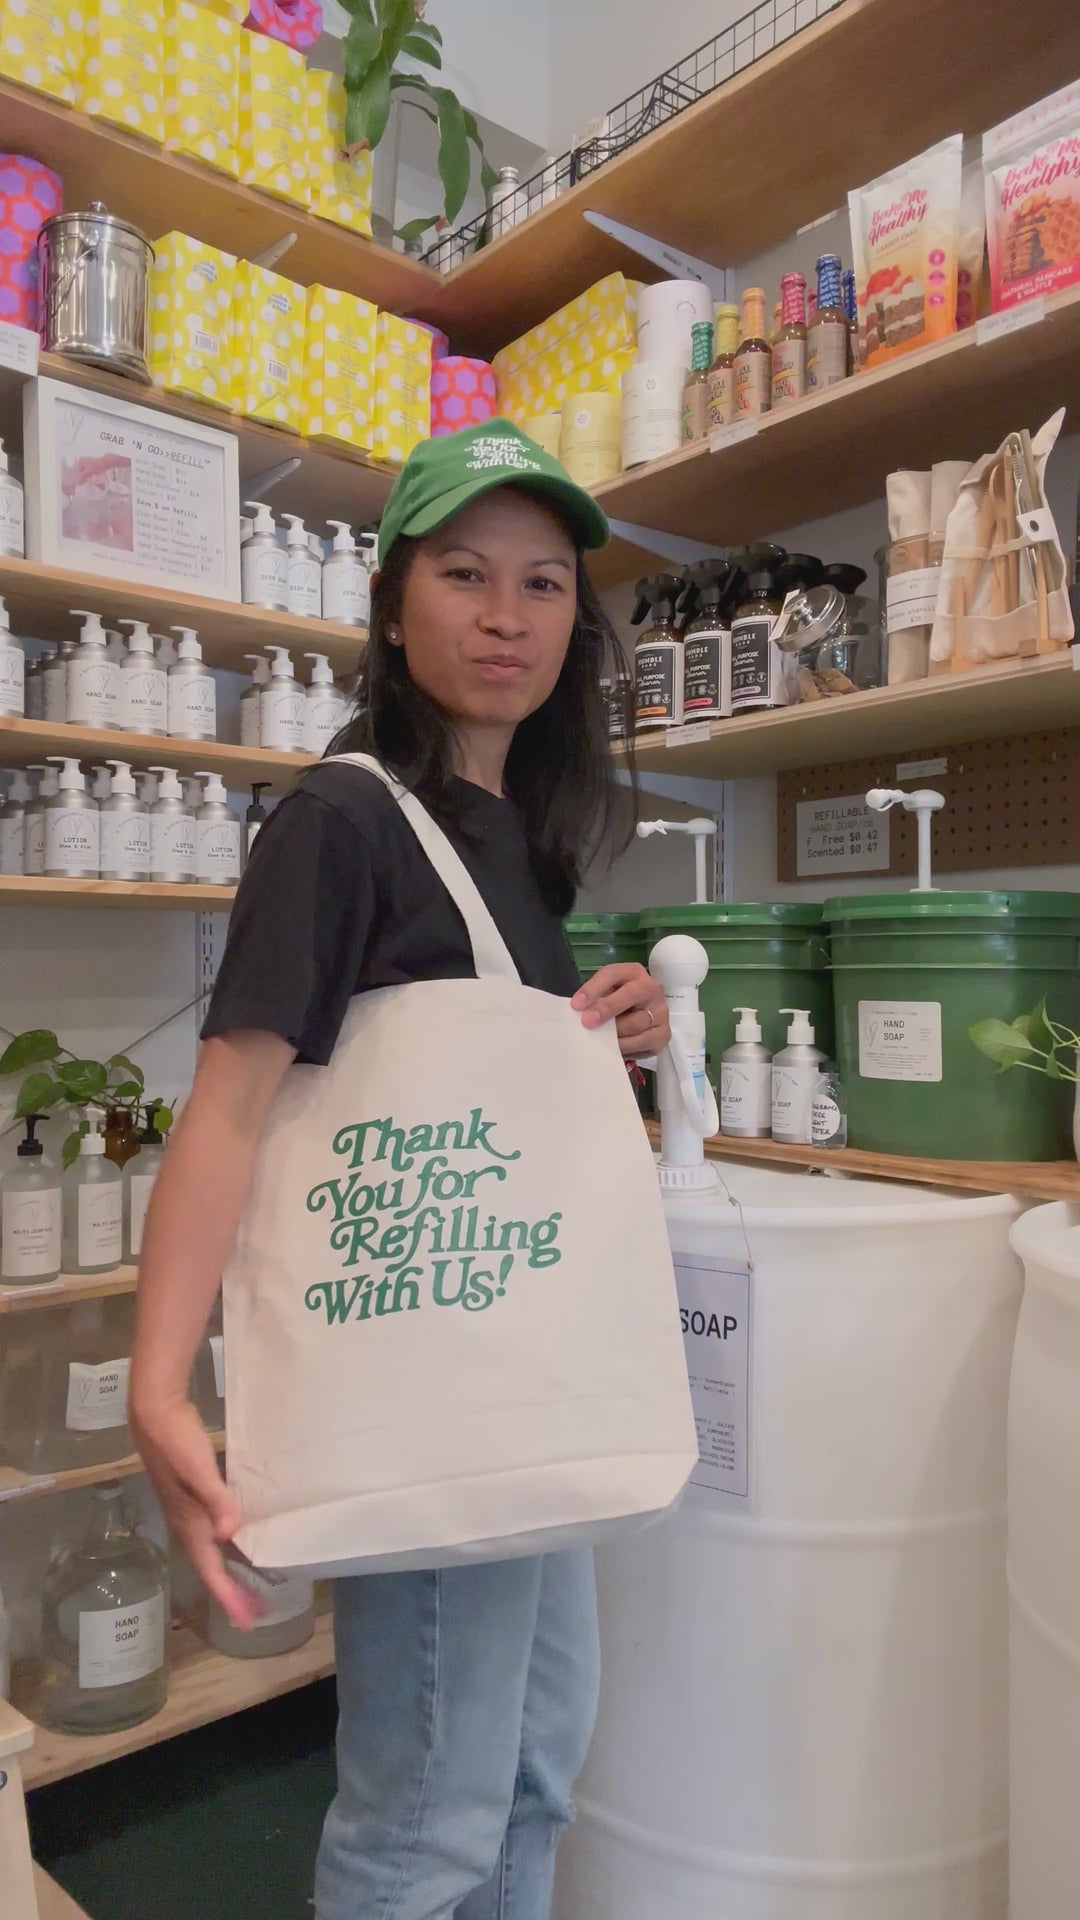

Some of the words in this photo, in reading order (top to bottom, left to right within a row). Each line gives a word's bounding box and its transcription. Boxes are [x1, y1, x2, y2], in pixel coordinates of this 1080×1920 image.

[868, 203, 928, 247] Healthy
[99, 431, 125, 445] GRAB
[814, 806, 869, 822] REFILLABLE
[822, 835, 845, 845] Free
[849, 830, 879, 843] $0.42
[807, 847, 845, 859] Scented
[849, 843, 879, 855] $0.47
[883, 1020, 905, 1028] HAND
[332, 1108, 521, 1171] Thank
[306, 1172, 404, 1222] You
[393, 1156, 506, 1220] for
[330, 1205, 563, 1274] Refilling
[304, 1266, 424, 1325] With
[432, 1254, 514, 1311] Us!
[680, 1308, 737, 1339] SOAP
[99, 1373, 119, 1382] HAND
[99, 1385, 119, 1394] SOAP
[115, 1616, 139, 1629] HAND
[115, 1629, 139, 1642] SOAP
